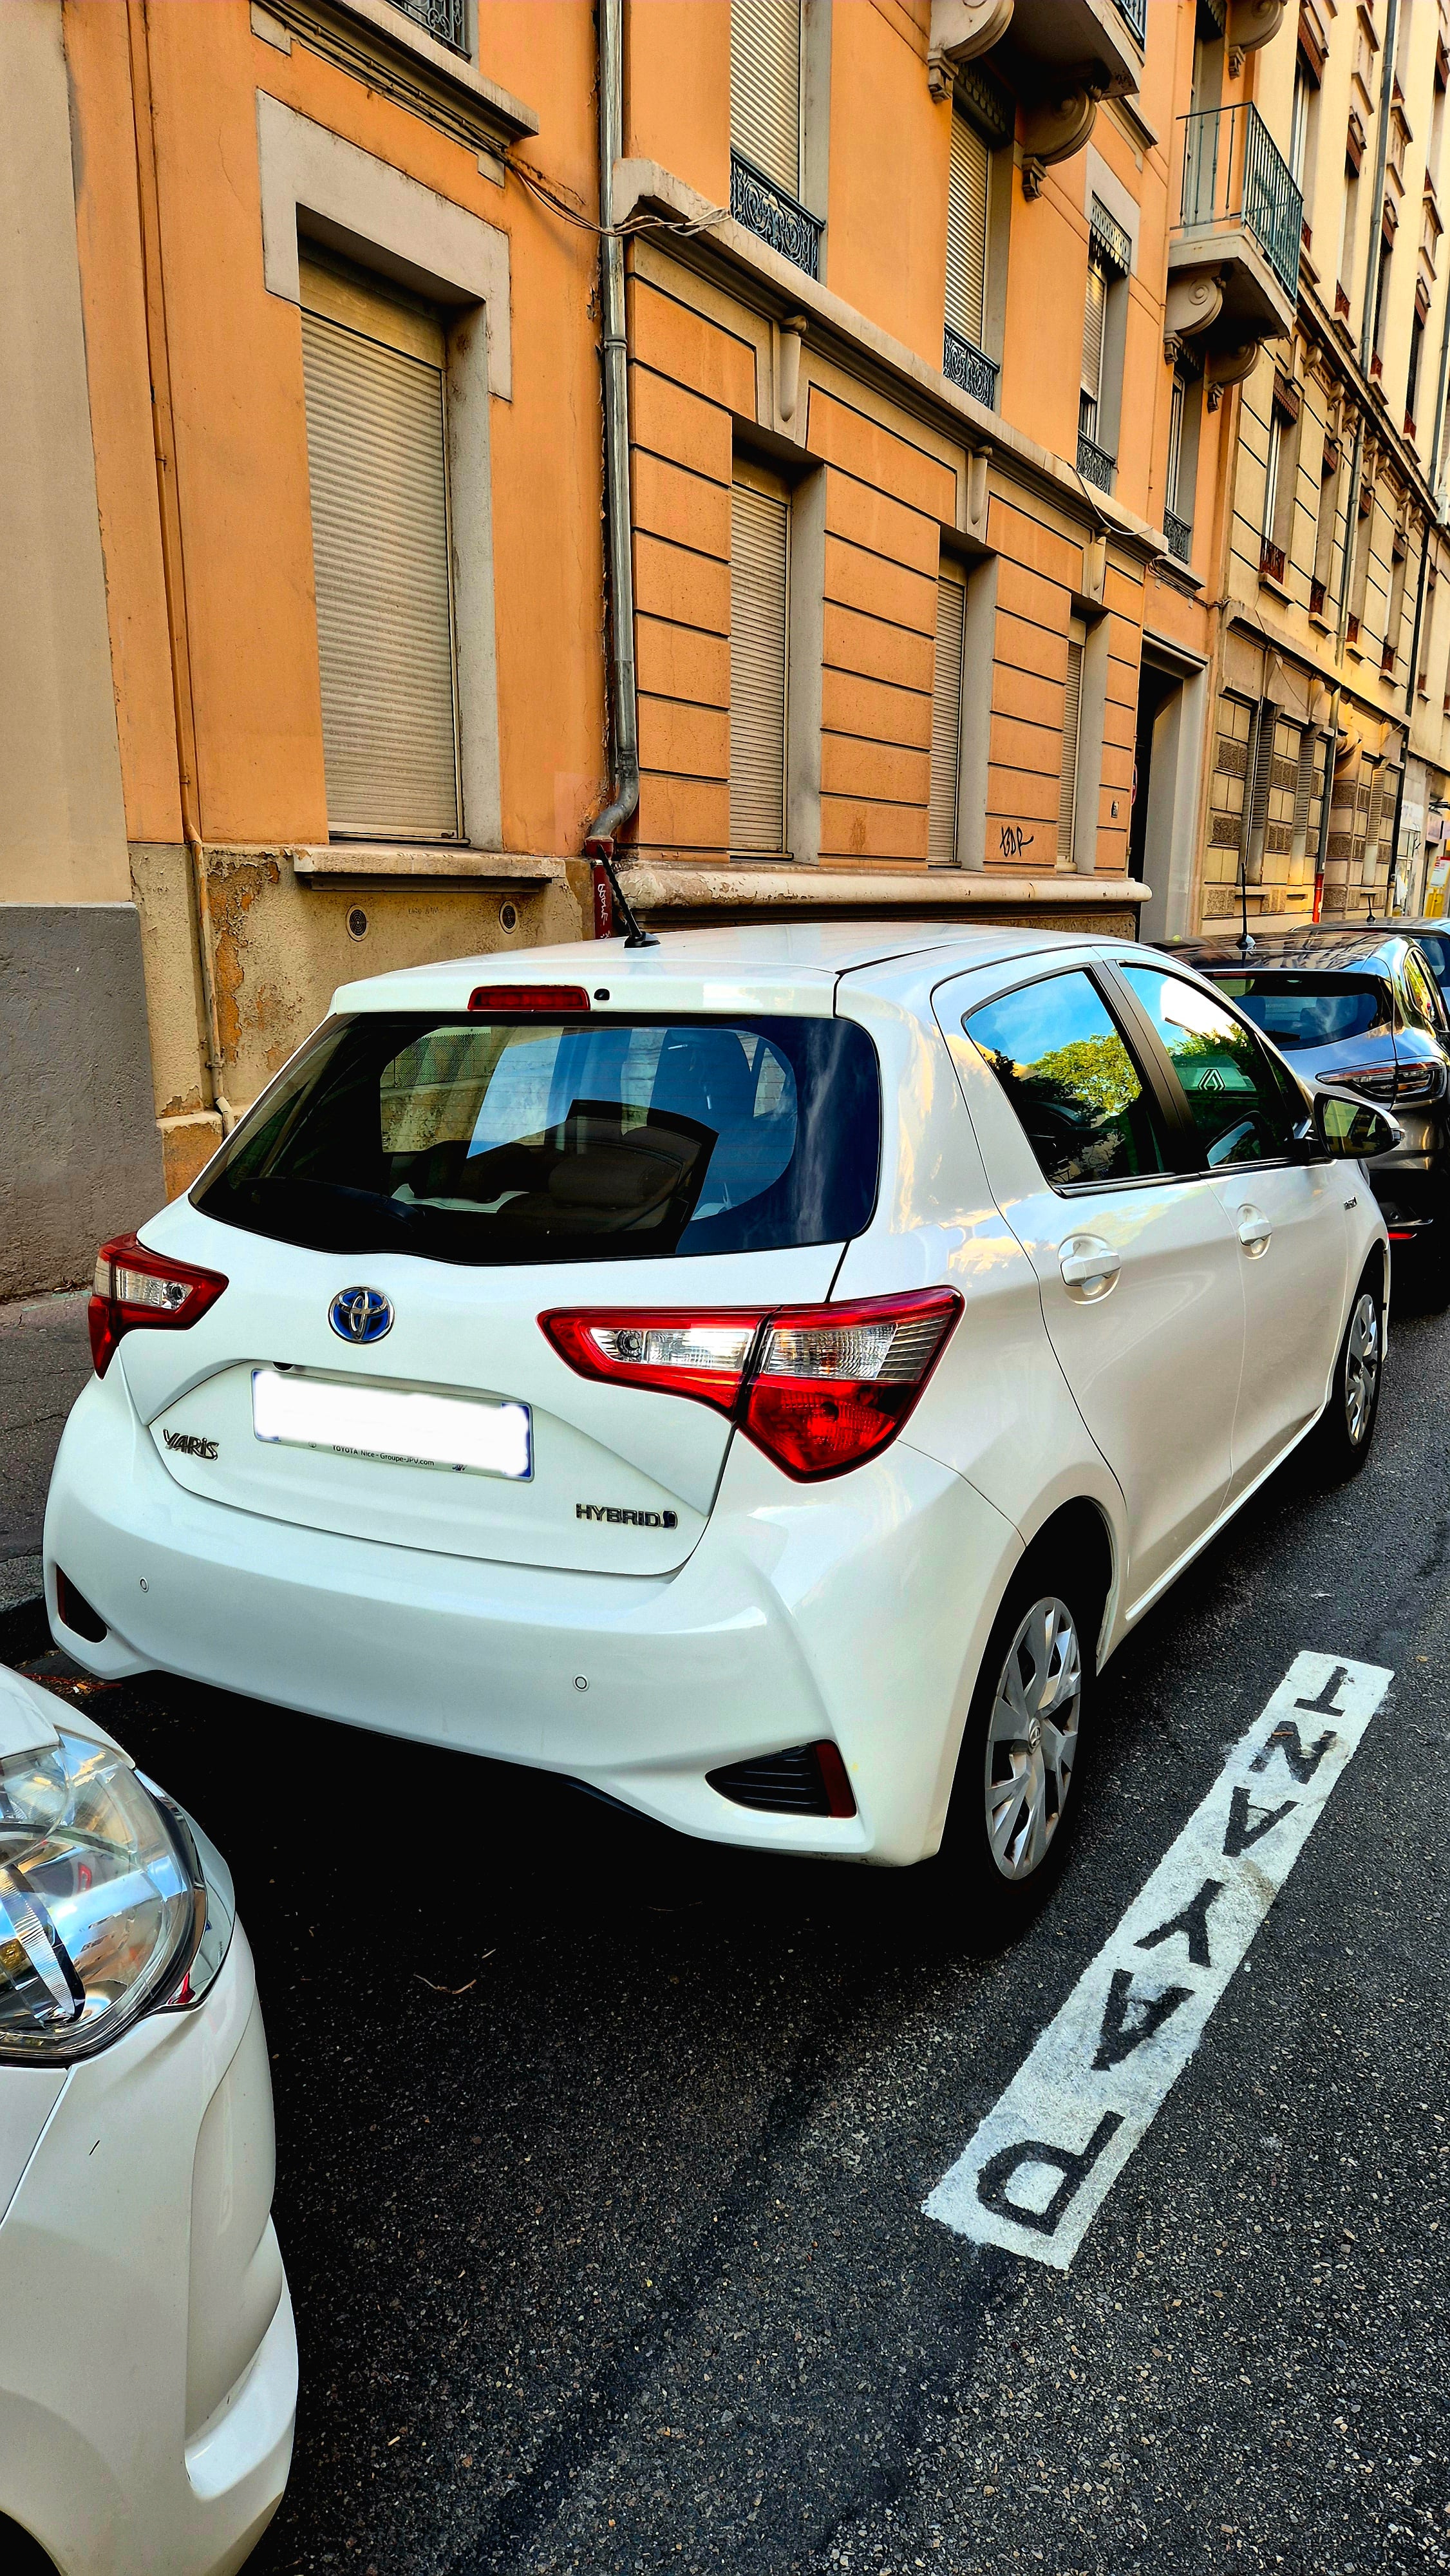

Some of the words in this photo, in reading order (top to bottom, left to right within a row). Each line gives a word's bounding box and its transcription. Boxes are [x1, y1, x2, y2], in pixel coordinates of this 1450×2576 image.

[332, 1444, 358, 1455] TOYOTA
[361, 1450, 375, 1458] Nice
[380, 1452, 435, 1466] Groupe-JPV.com
[576, 1503, 661, 1529] HYBRID
[975, 1665, 1350, 2237] PAYANT
